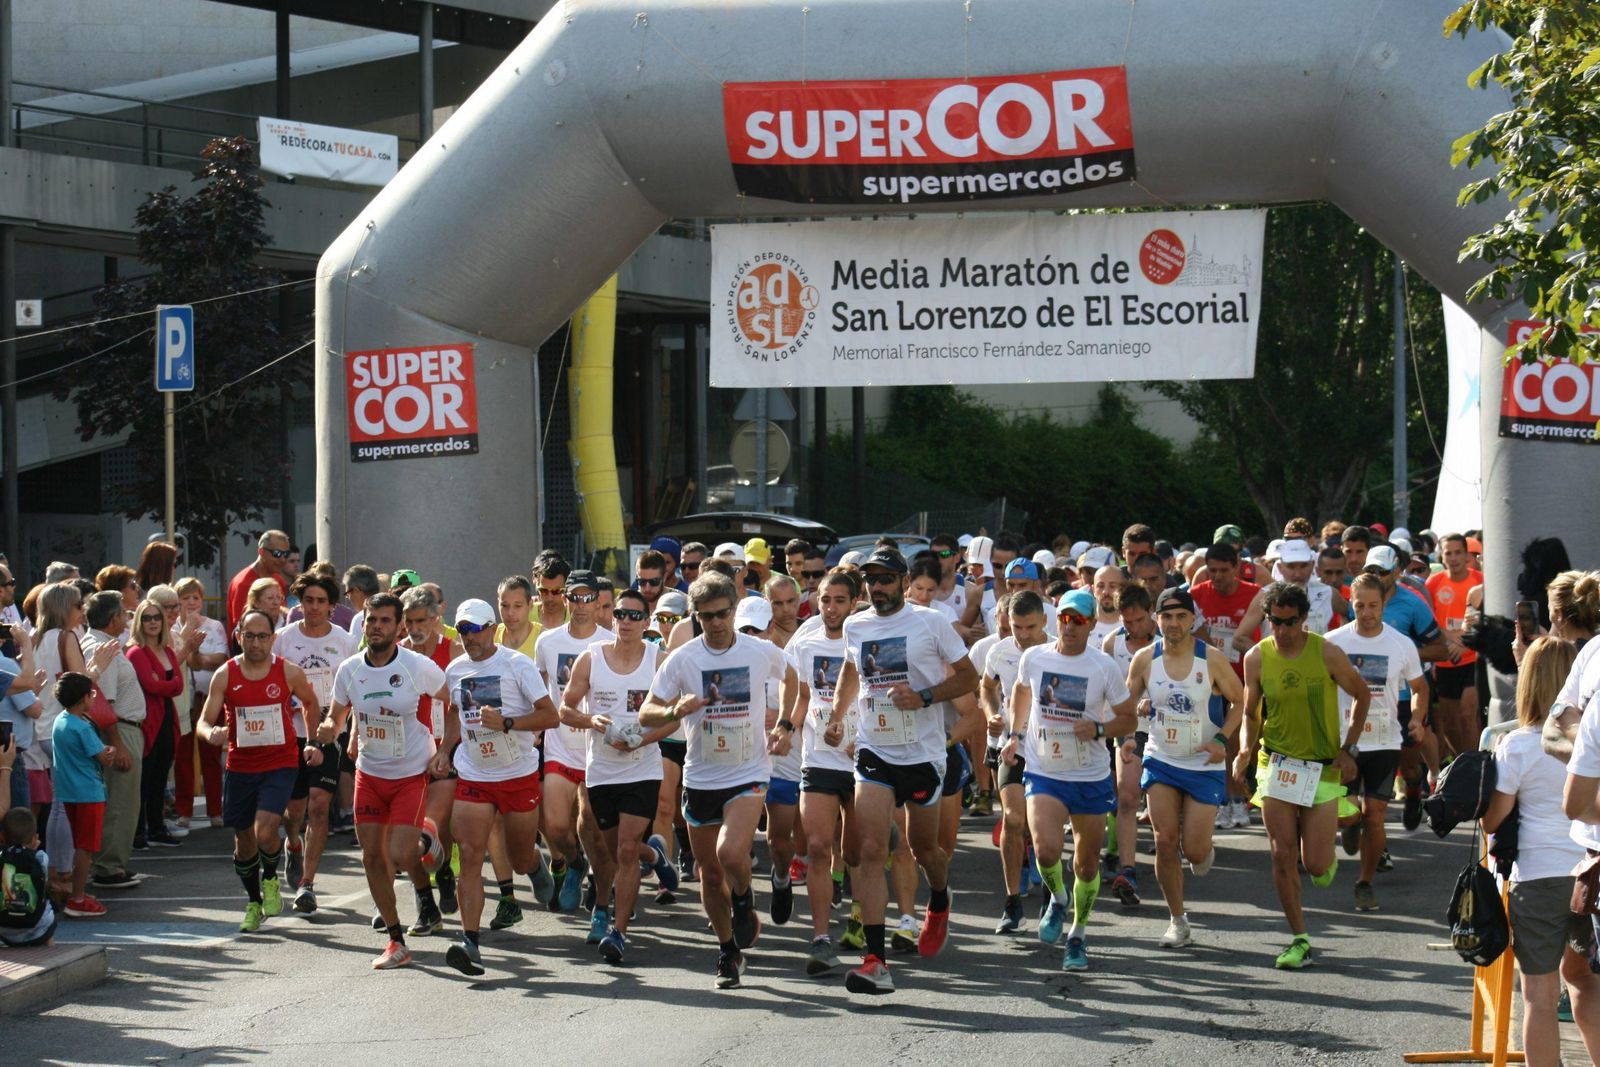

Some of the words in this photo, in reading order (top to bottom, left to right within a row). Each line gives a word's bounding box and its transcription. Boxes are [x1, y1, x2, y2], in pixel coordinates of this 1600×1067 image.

[745, 79, 1115, 160] SUPERCOR
[863, 157, 1123, 203] supermercados
[754, 252, 809, 283] DEPORTIVA
[831, 258, 930, 291] Media
[939, 254, 1080, 288] Maratón
[1090, 253, 1130, 285] de
[831, 301, 889, 333] San
[896, 300, 1027, 331] Lorenzo
[1036, 297, 1075, 328] de
[1084, 295, 1113, 327] El
[1121, 292, 1250, 326] Escorial
[164, 316, 186, 380] P
[744, 344, 768, 362] SAN
[774, 311, 816, 362] LORENZO
[832, 343, 902, 361] Memorial
[907, 342, 979, 360] Francisco
[983, 340, 1063, 358] Fernández
[1066, 339, 1152, 358] Samaniego
[352, 349, 467, 389] SUPER
[354, 383, 470, 436] COR
[358, 437, 471, 460] supermercados
[244, 720, 265, 732] 302
[878, 713, 887, 728] 6
[366, 726, 386, 740] 510
[717, 735, 726, 748] 5
[1166, 728, 1177, 740] 17
[479, 741, 496, 754] 32
[1052, 742, 1061, 754] 2
[1276, 769, 1298, 785] 104
